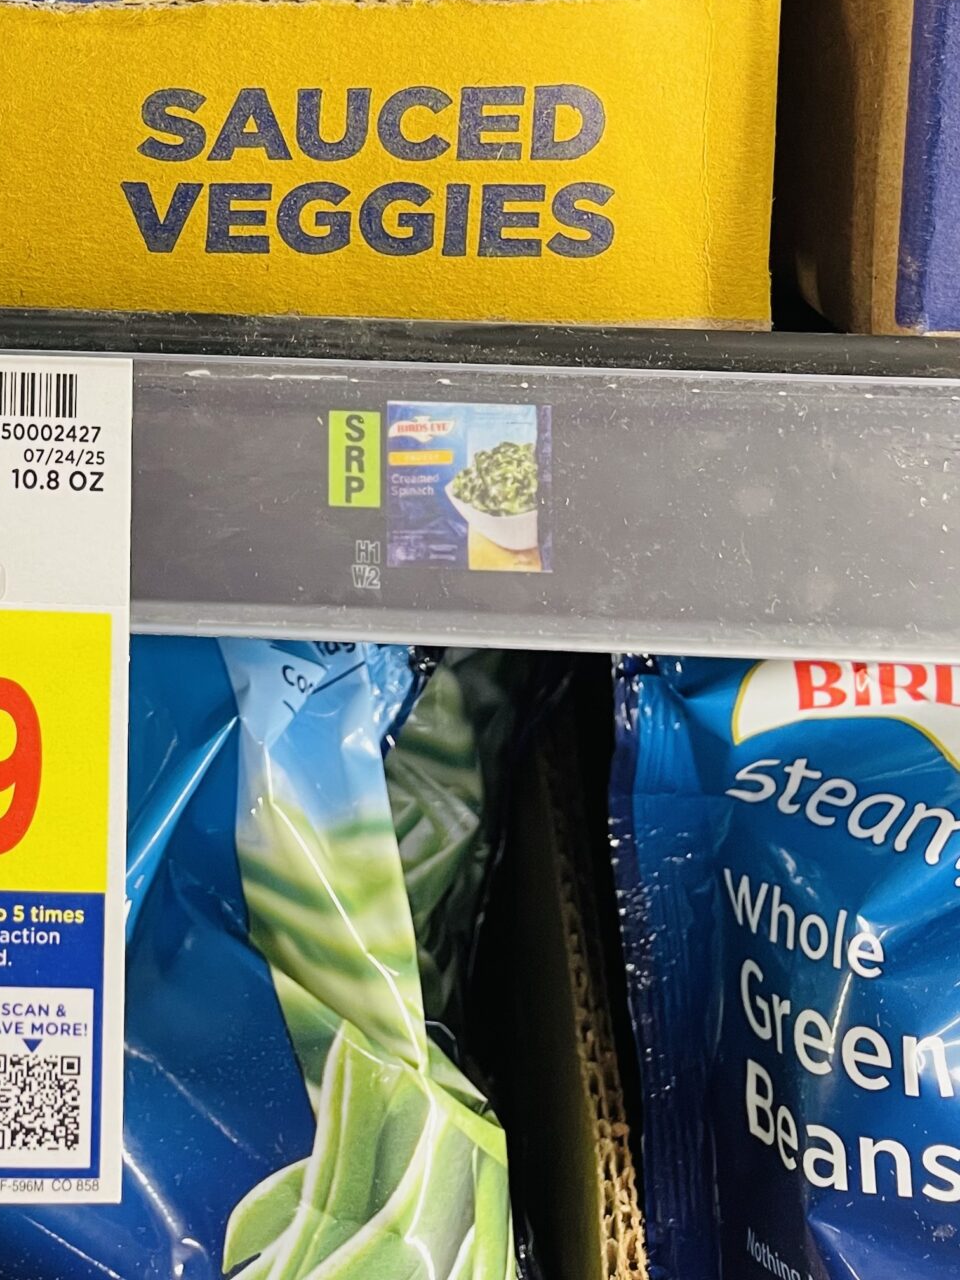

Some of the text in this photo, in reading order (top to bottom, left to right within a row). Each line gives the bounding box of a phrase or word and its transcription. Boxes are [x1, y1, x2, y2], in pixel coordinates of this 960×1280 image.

[137, 84, 606, 162] SAUCED
[121, 181, 615, 258] VEGGIES
[23, 448, 105, 467] 07/24/25
[11, 468, 60, 490] 10.8
[68, 470, 105, 492] OZ
[12, 905, 25, 922] 5
[30, 905, 85, 924] times
[723, 867, 885, 979] Whole
[1, 1002, 67, 1017] SCAN &
[31, 1022, 88, 1037] MORE!
[741, 958, 956, 1099] Green
[745, 1058, 960, 1203] Beans
[52, 1179, 72, 1192] CO
[76, 1180, 99, 1193] 858
